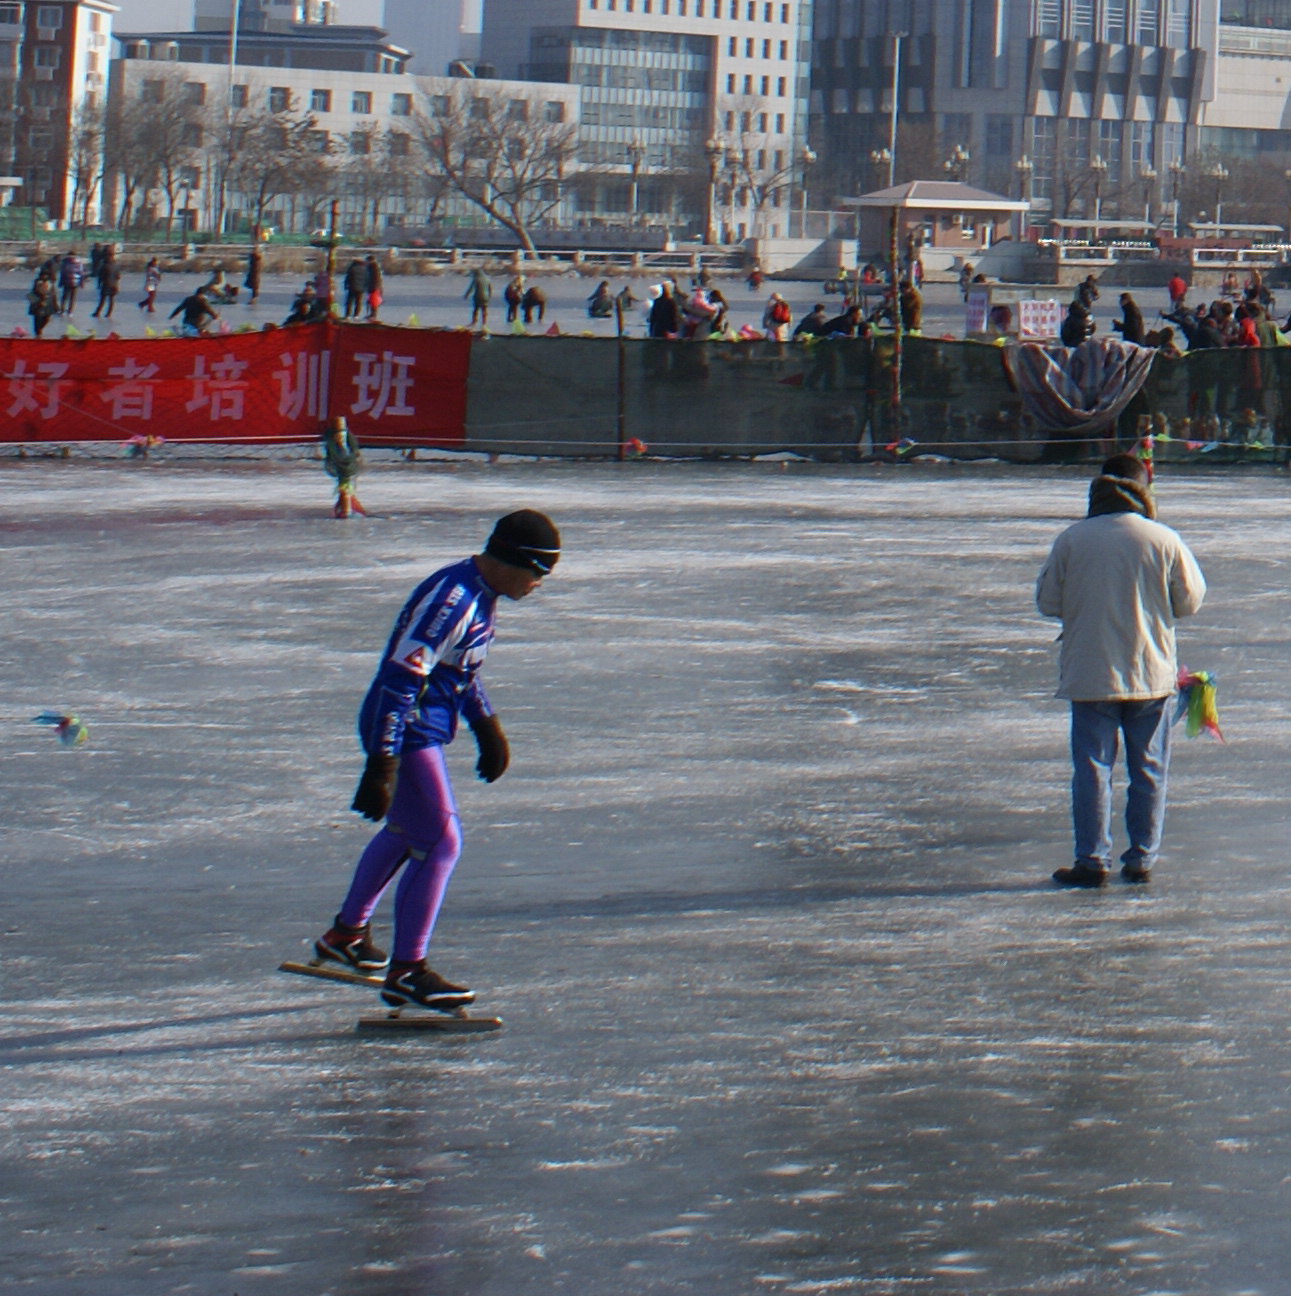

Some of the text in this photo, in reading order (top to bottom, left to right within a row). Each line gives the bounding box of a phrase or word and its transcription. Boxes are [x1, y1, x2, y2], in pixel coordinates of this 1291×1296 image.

[6, 351, 416, 420] 好者培训班
